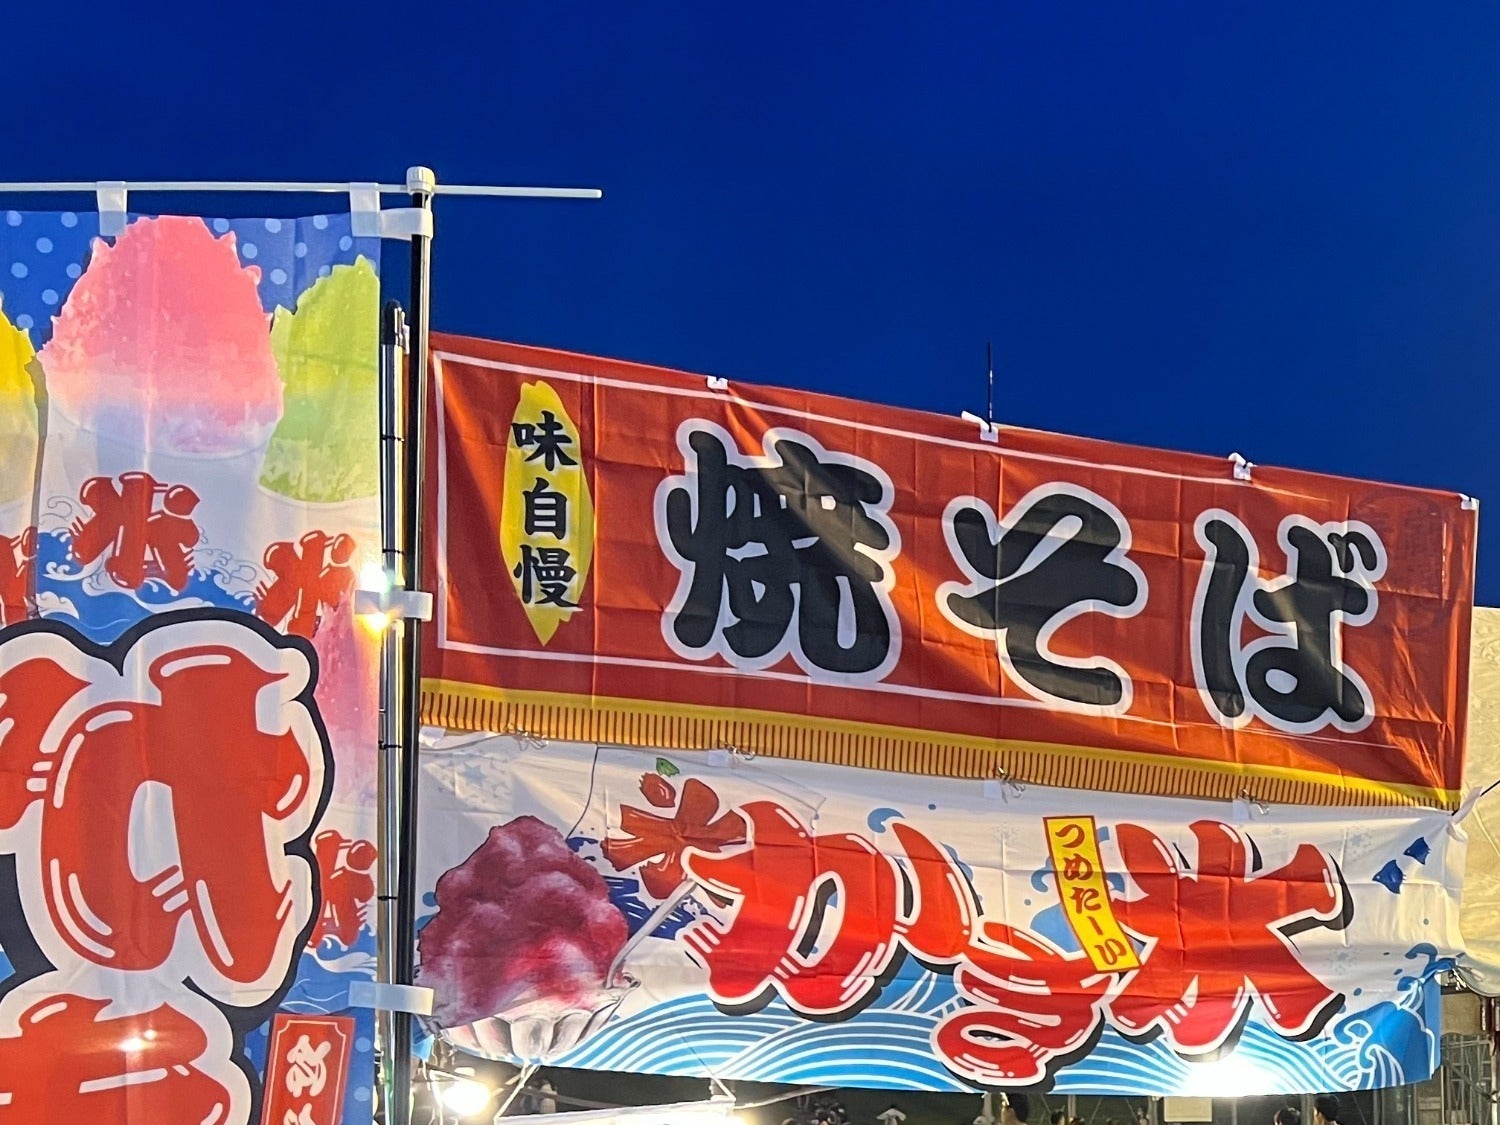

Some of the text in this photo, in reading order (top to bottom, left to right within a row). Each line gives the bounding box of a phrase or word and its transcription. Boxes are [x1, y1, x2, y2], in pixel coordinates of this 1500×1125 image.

[511, 411, 582, 610] 味自慢
[662, 424, 1384, 728] 焼そば
[682, 798, 1340, 1082] かき氷
